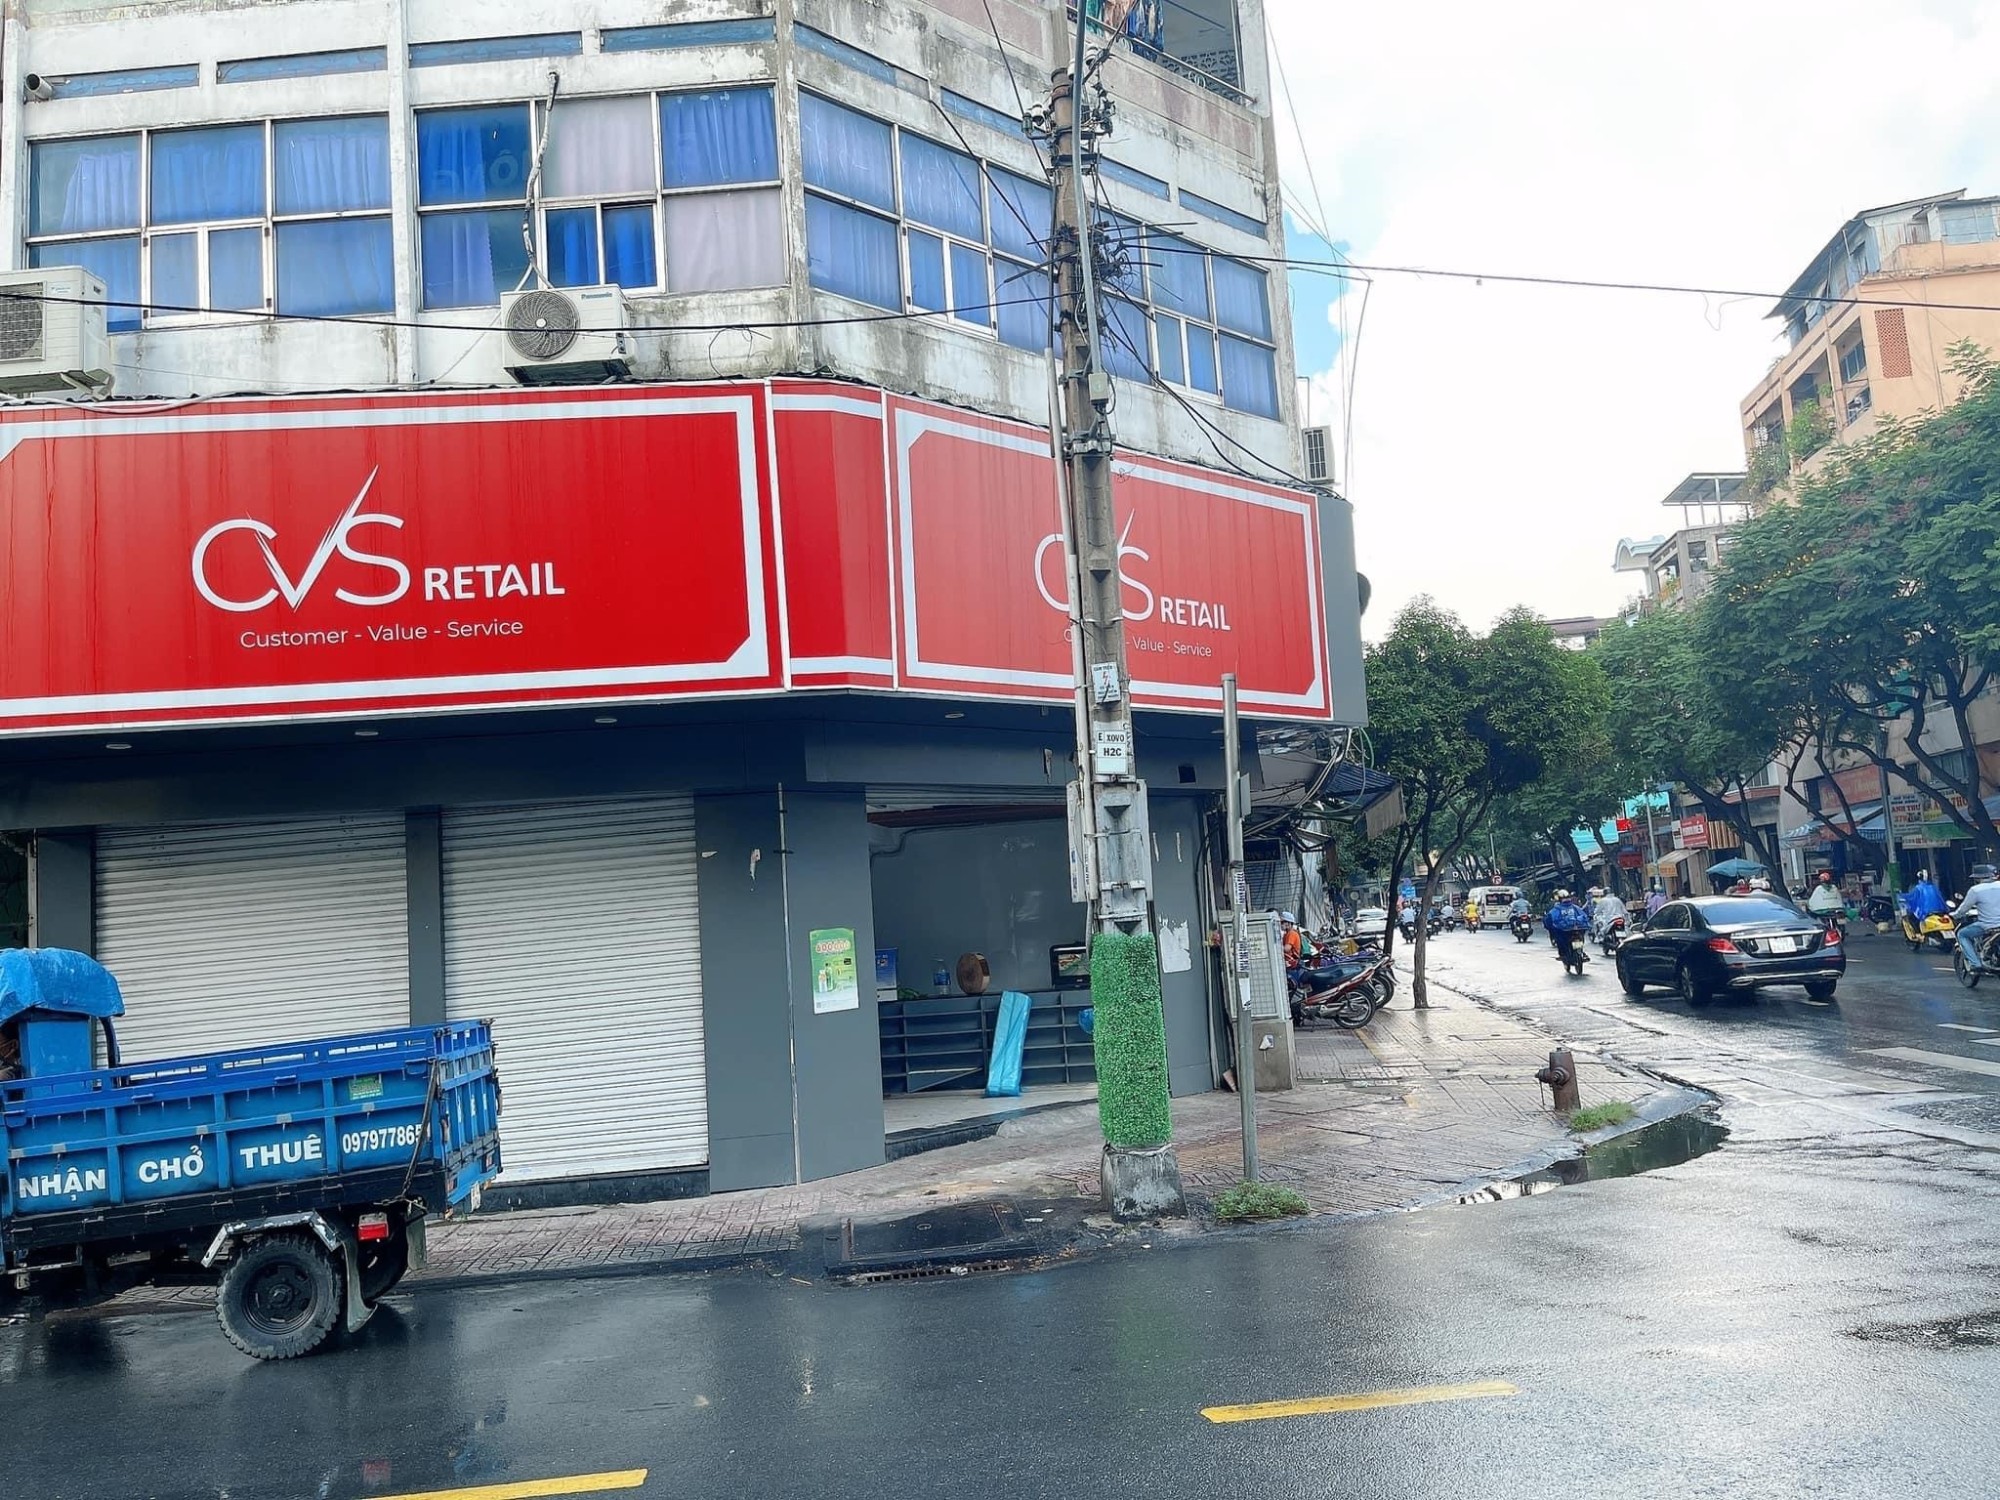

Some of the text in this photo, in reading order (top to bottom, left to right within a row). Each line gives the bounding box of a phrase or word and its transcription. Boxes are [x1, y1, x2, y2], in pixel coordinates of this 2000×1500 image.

[192, 464, 566, 613] CVS RETAIL
[1034, 508, 1231, 632] CS RETAIL
[240, 628, 349, 649] Customer
[367, 624, 428, 643] Value
[447, 618, 524, 639] Service
[1132, 636, 1164, 653] Value
[1173, 640, 1213, 658] Service
[1103, 747, 1122, 757] H2C
[19, 1167, 106, 1201] NHẬN
[138, 1145, 205, 1183] CHỞ
[239, 1133, 322, 1169] THUÊ
